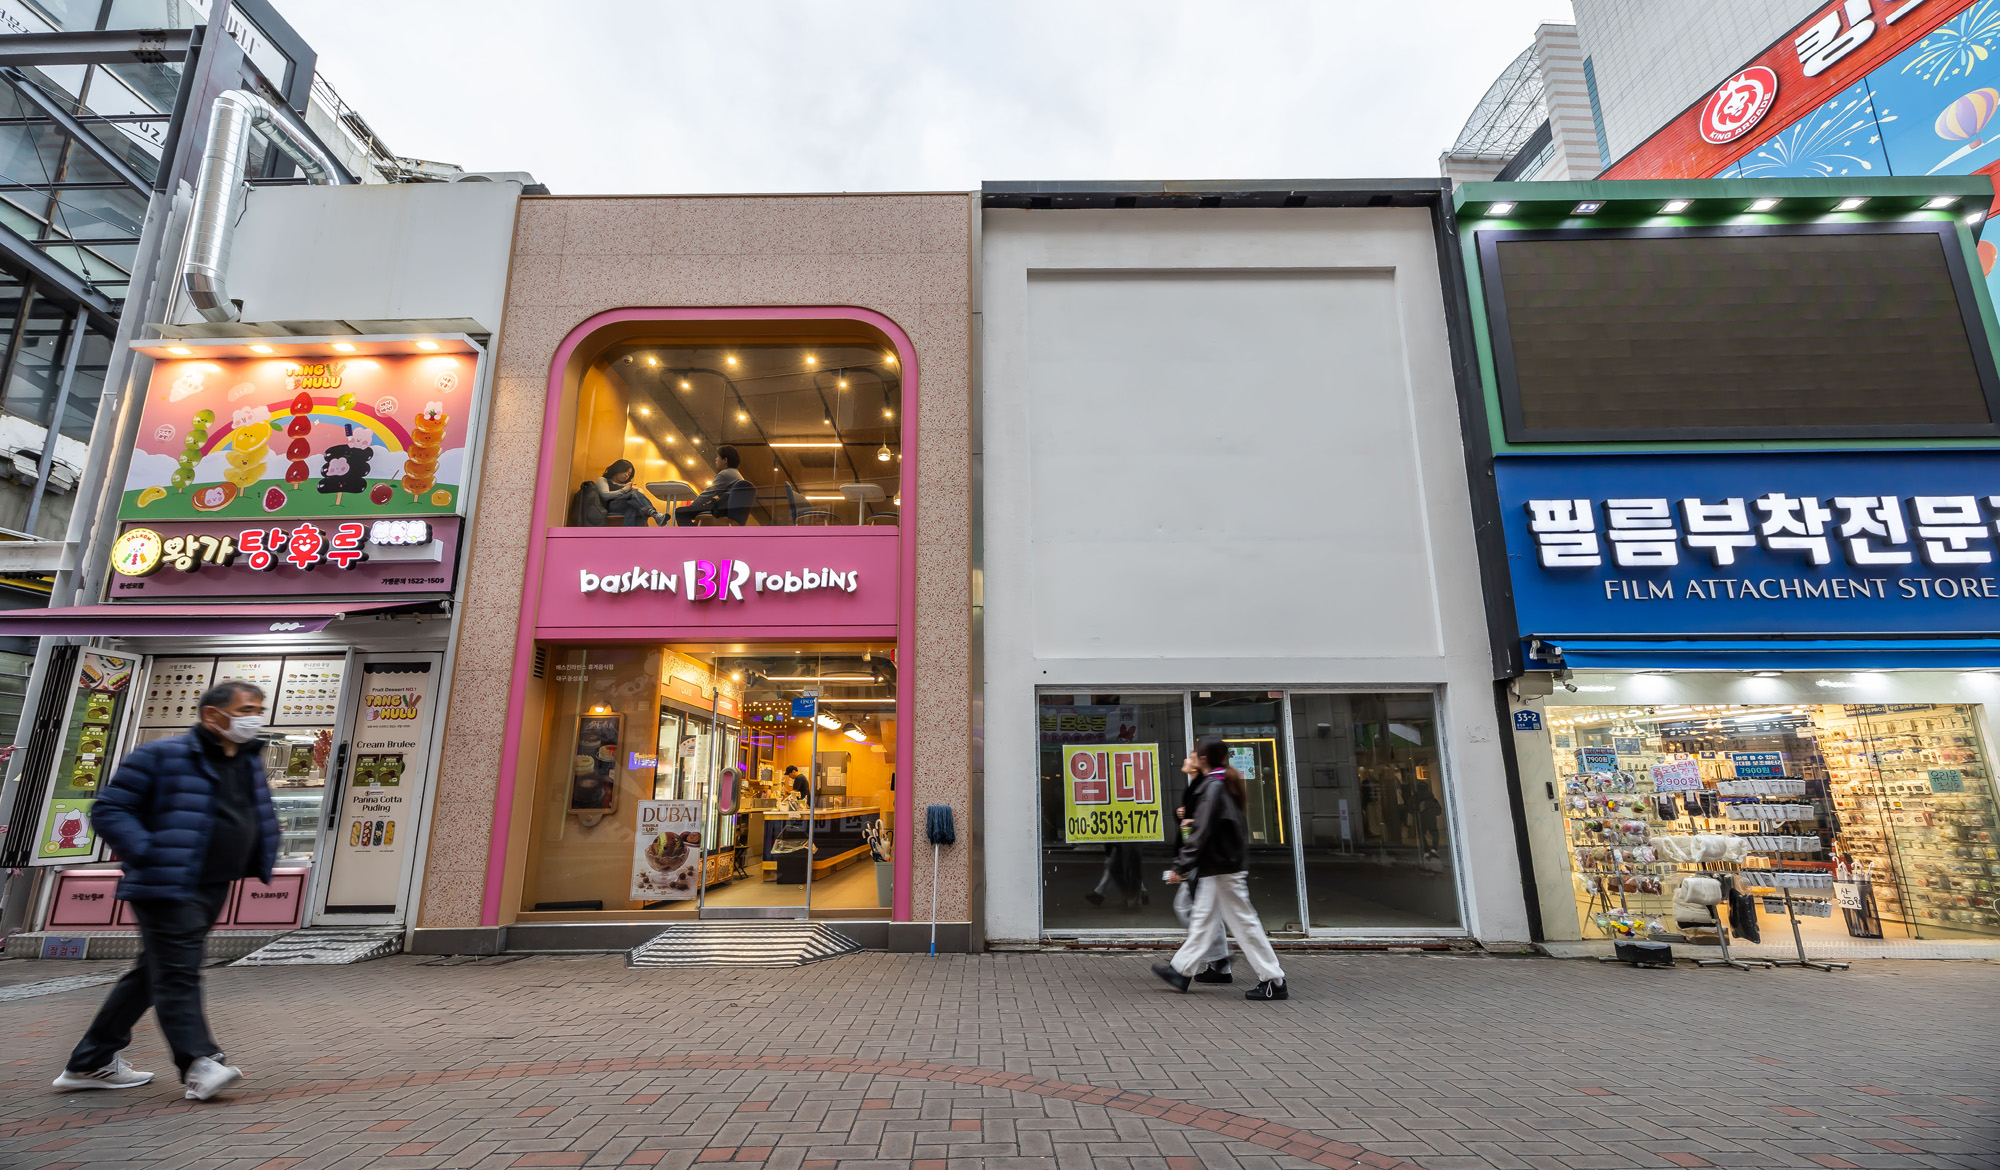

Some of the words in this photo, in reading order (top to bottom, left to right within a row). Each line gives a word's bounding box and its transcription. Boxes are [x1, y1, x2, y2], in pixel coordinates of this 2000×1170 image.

[1794, 0, 1938, 77] 킹
[1709, 130, 1732, 140] KING
[1735, 92, 1772, 135] ARCADE
[302, 376, 342, 389] HULU
[1523, 493, 2000, 566] 필름부착전문
[407, 577, 445, 585] 1522-1509
[580, 566, 678, 594] baskin
[683, 559, 751, 601] BR
[755, 567, 859, 593] robbins
[1604, 580, 1674, 600] FILM
[1686, 578, 1888, 599] ATTACHMENT
[1899, 577, 1999, 598] STORE
[365, 694, 402, 707] TANG
[380, 707, 418, 720] HULU
[1517, 713, 1538, 722] 33-2
[357, 740, 385, 749] Cream
[387, 740, 416, 748] Brulee
[1069, 751, 1156, 805] 임대
[362, 804, 391, 813] Puding
[642, 807, 698, 823] DUBAI
[1068, 810, 1159, 835] 010-3513-1717
[50, 946, 79, 957] 점검구
